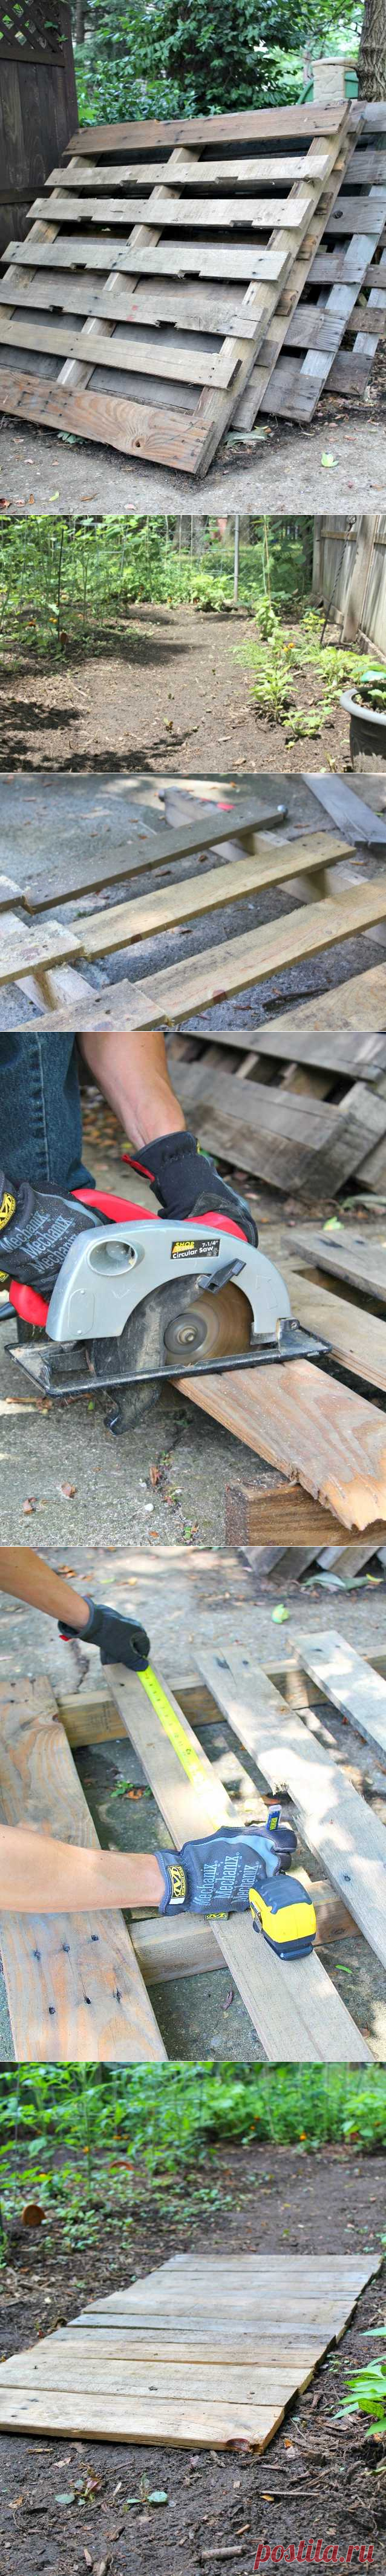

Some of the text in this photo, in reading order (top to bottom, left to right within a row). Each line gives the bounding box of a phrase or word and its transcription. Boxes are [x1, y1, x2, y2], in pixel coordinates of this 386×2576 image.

[0, 1210, 48, 1251] Mechanix
[19, 1215, 72, 1259] Mechanix
[172, 1249, 198, 1259] Circular
[193, 1863, 217, 1906] Mechanix
[214, 1855, 239, 1899] Mechanix
